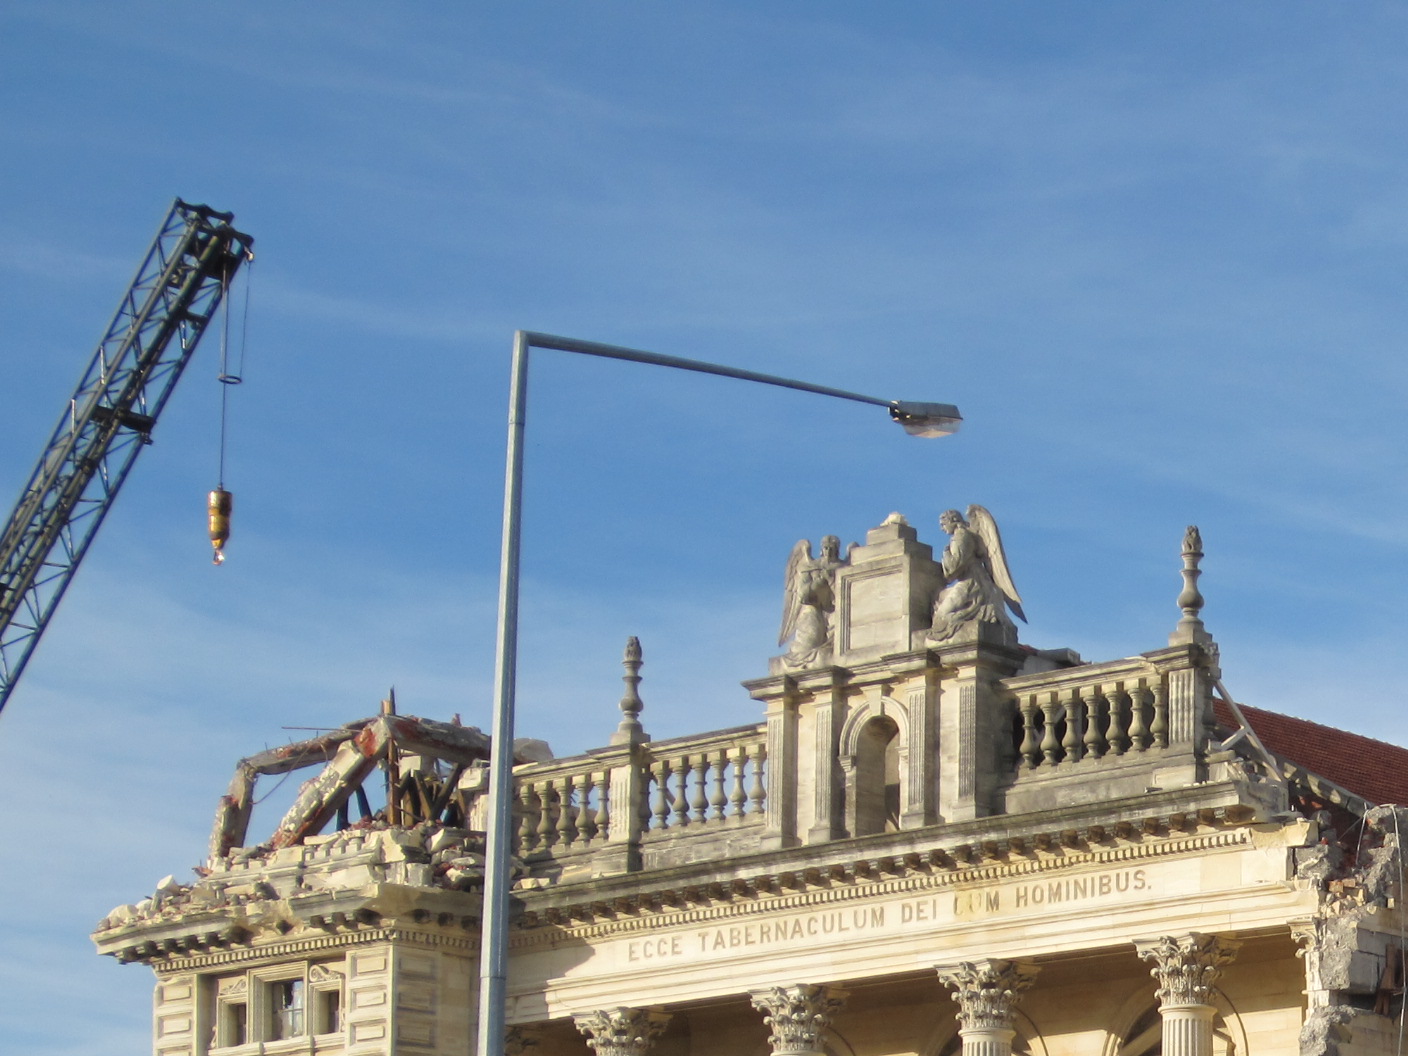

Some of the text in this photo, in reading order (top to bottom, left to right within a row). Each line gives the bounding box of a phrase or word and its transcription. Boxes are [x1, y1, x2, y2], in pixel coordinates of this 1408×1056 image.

[628, 935, 683, 962] ECCE
[698, 906, 885, 953] TABERNACULUM
[901, 899, 937, 924] DEI
[1015, 869, 1152, 908] HOMINIBUS.
